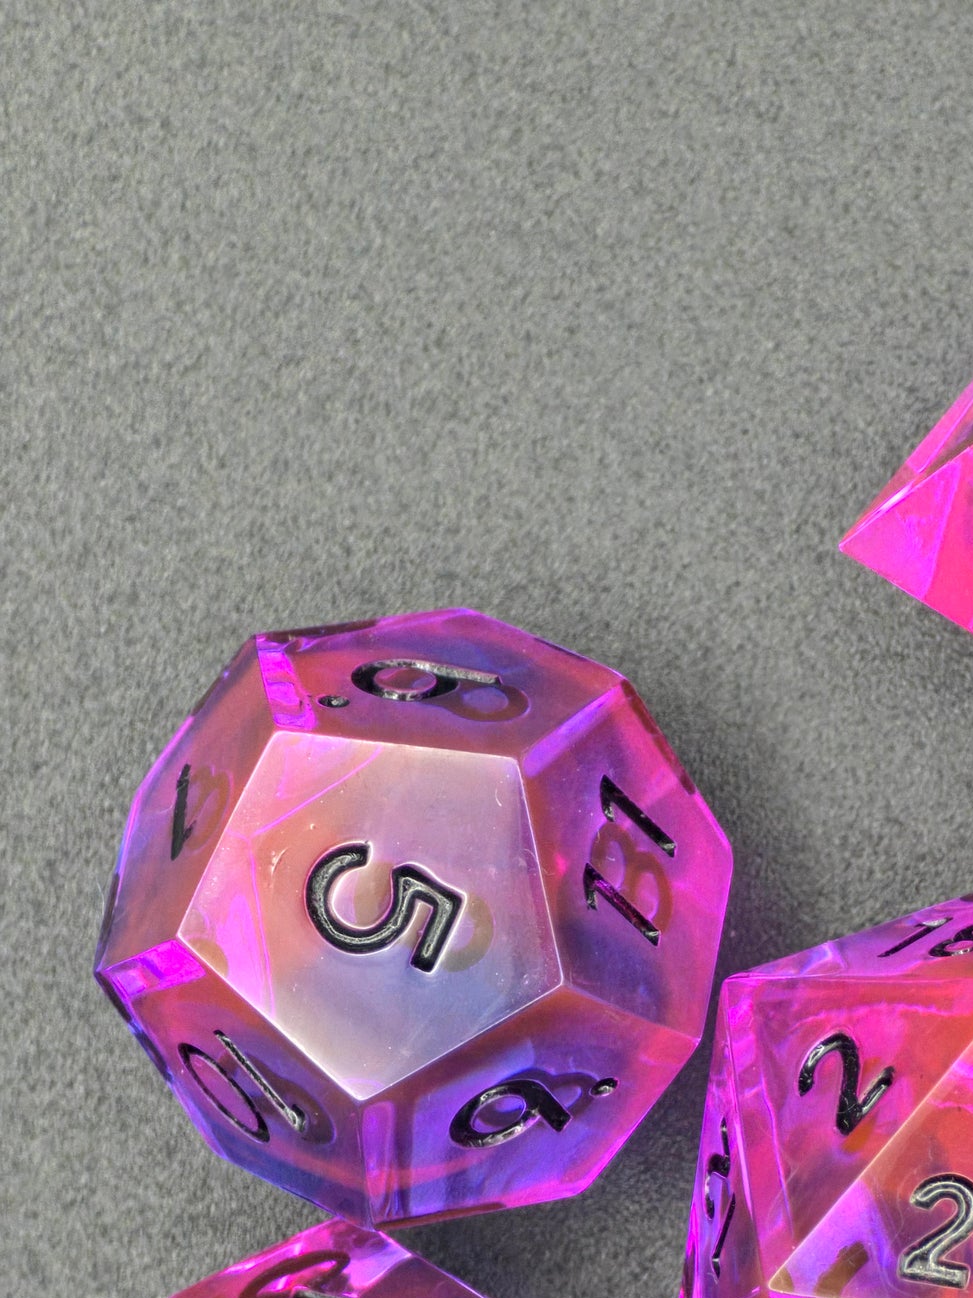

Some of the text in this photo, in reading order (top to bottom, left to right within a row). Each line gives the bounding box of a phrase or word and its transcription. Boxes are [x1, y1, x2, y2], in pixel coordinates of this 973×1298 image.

[304, 839, 468, 974] 5
[179, 1029, 307, 1144] 10
[798, 1031, 897, 1136] 2
